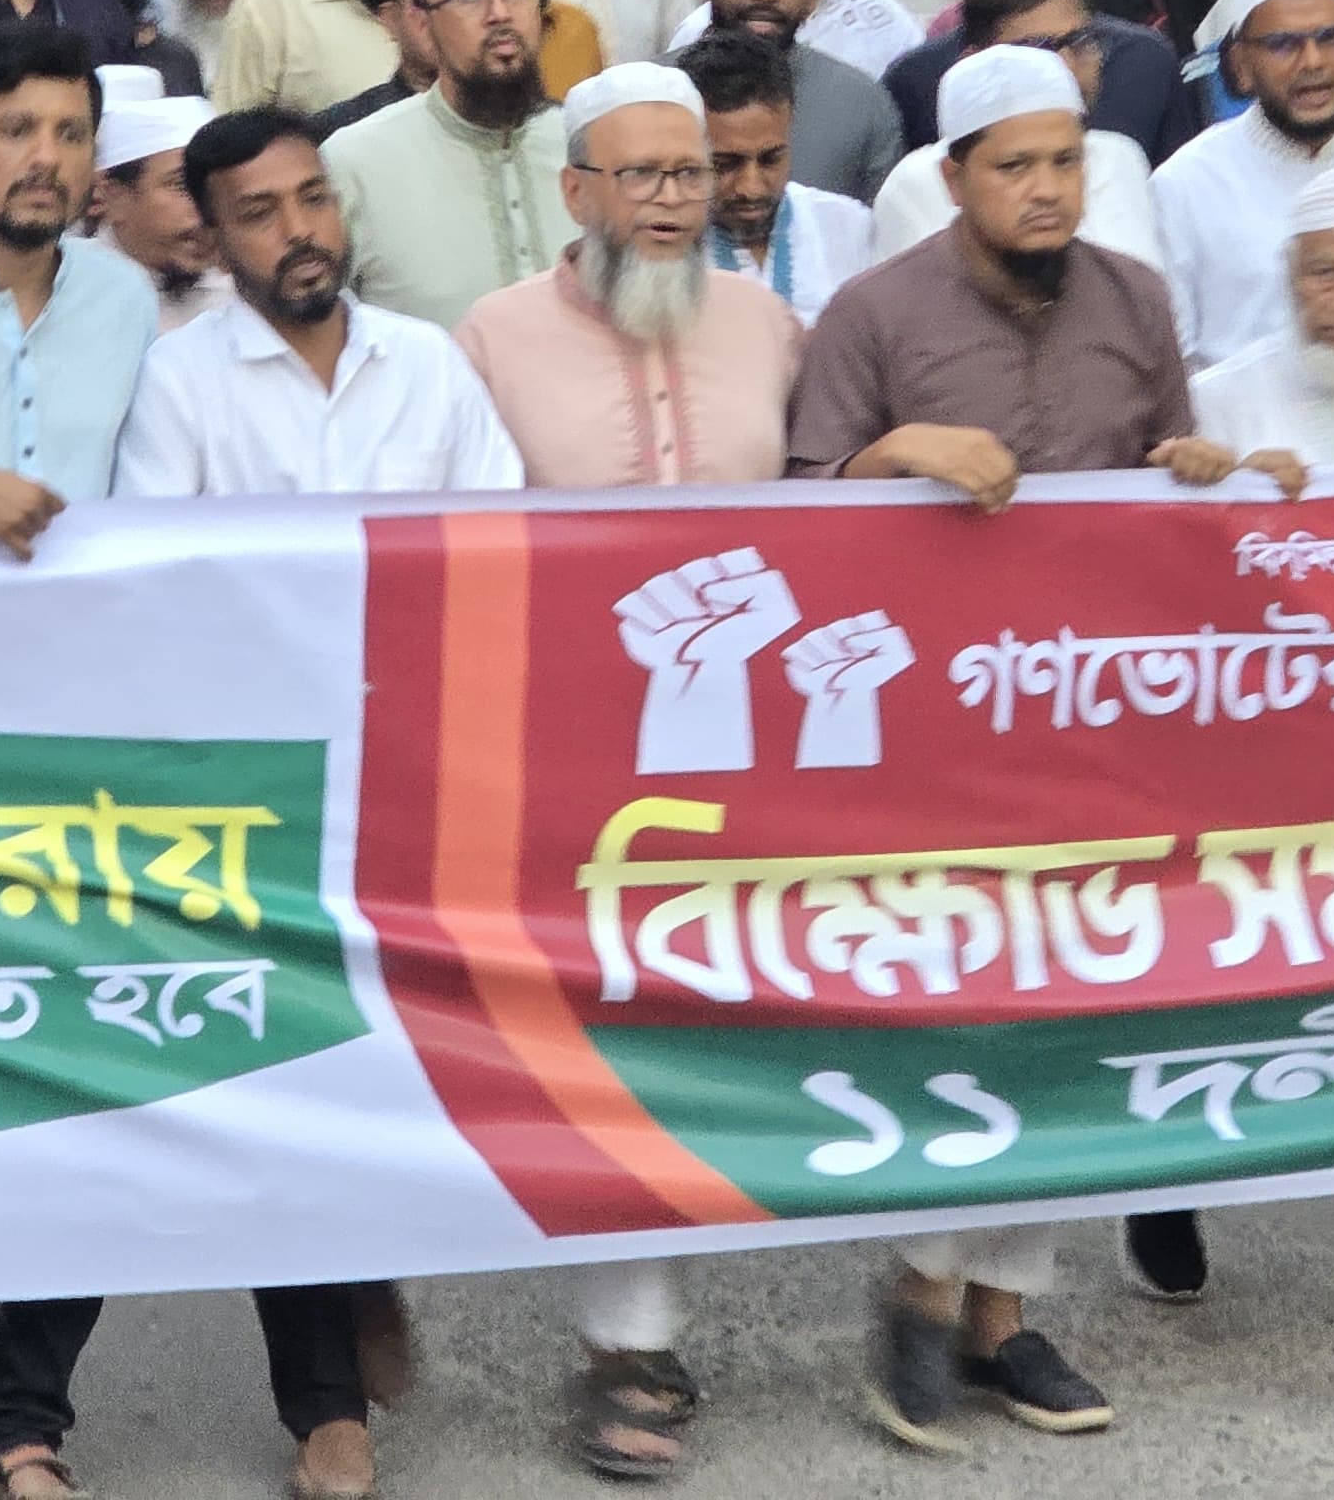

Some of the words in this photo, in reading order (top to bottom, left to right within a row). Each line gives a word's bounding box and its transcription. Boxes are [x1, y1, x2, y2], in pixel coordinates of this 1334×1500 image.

[577, 796, 1177, 1002] বিক্ষোভ
[79, 958, 280, 1045] হবে
[804, 1070, 1023, 1179] ১১
